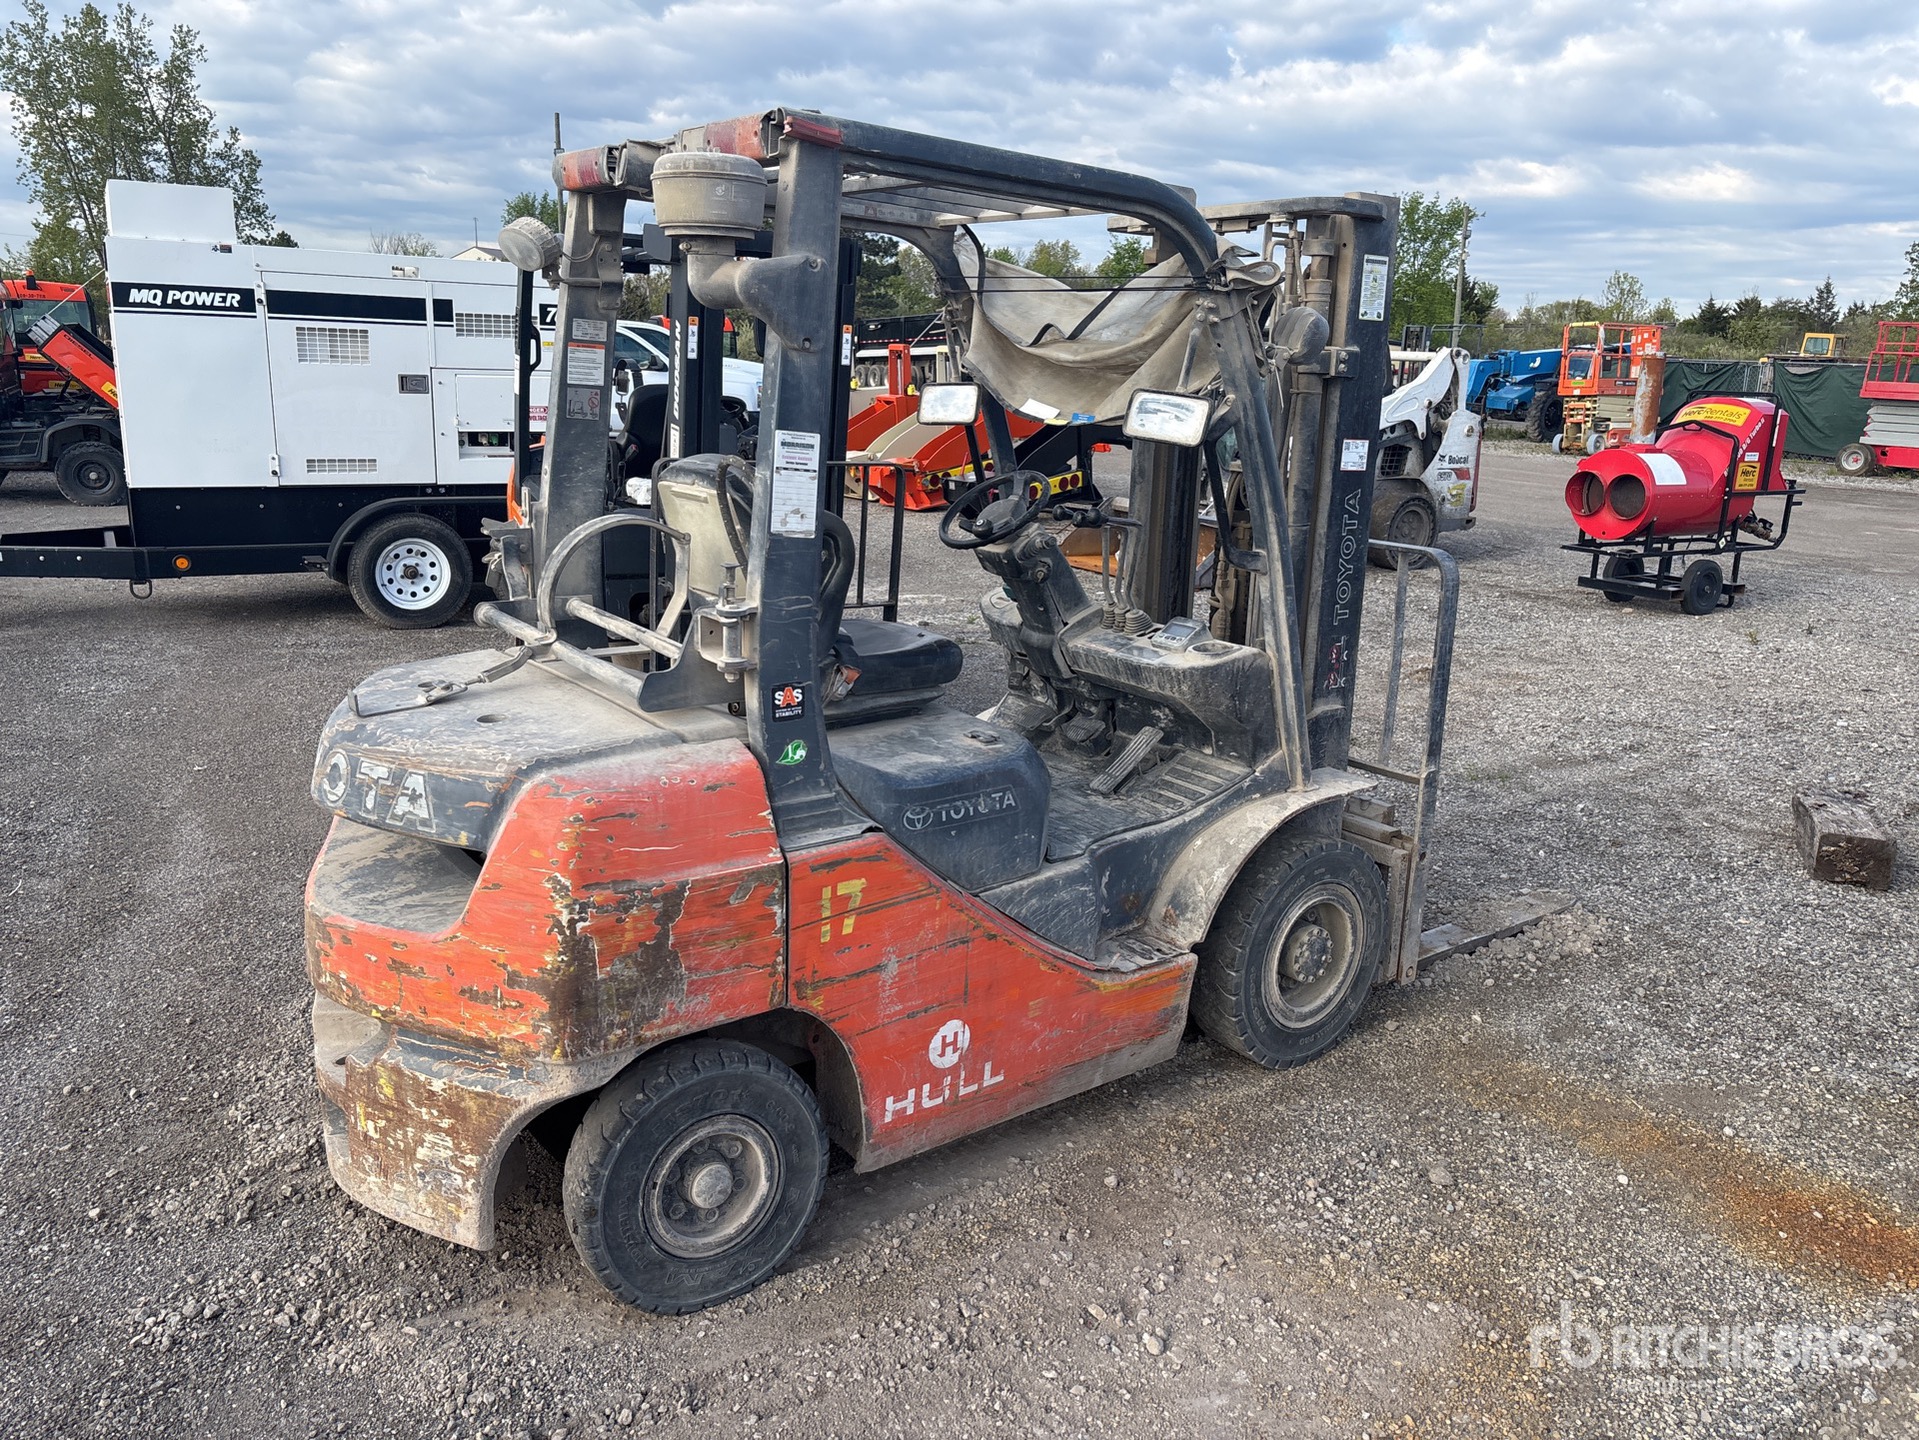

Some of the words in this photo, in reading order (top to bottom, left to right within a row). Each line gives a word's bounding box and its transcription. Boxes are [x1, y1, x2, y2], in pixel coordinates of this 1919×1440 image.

[128, 288, 162, 306] MQ
[167, 290, 241, 307] POWER
[673, 319, 681, 421] DOOSAN
[1447, 455, 1469, 465] Bobcat
[1740, 468, 1757, 478] Herc
[1333, 488, 1362, 626] TOYOTA
[774, 686, 803, 708] SAS
[936, 790, 1016, 822] TOYOTA
[820, 877, 867, 943] 17
[884, 1061, 1006, 1123] HULL
